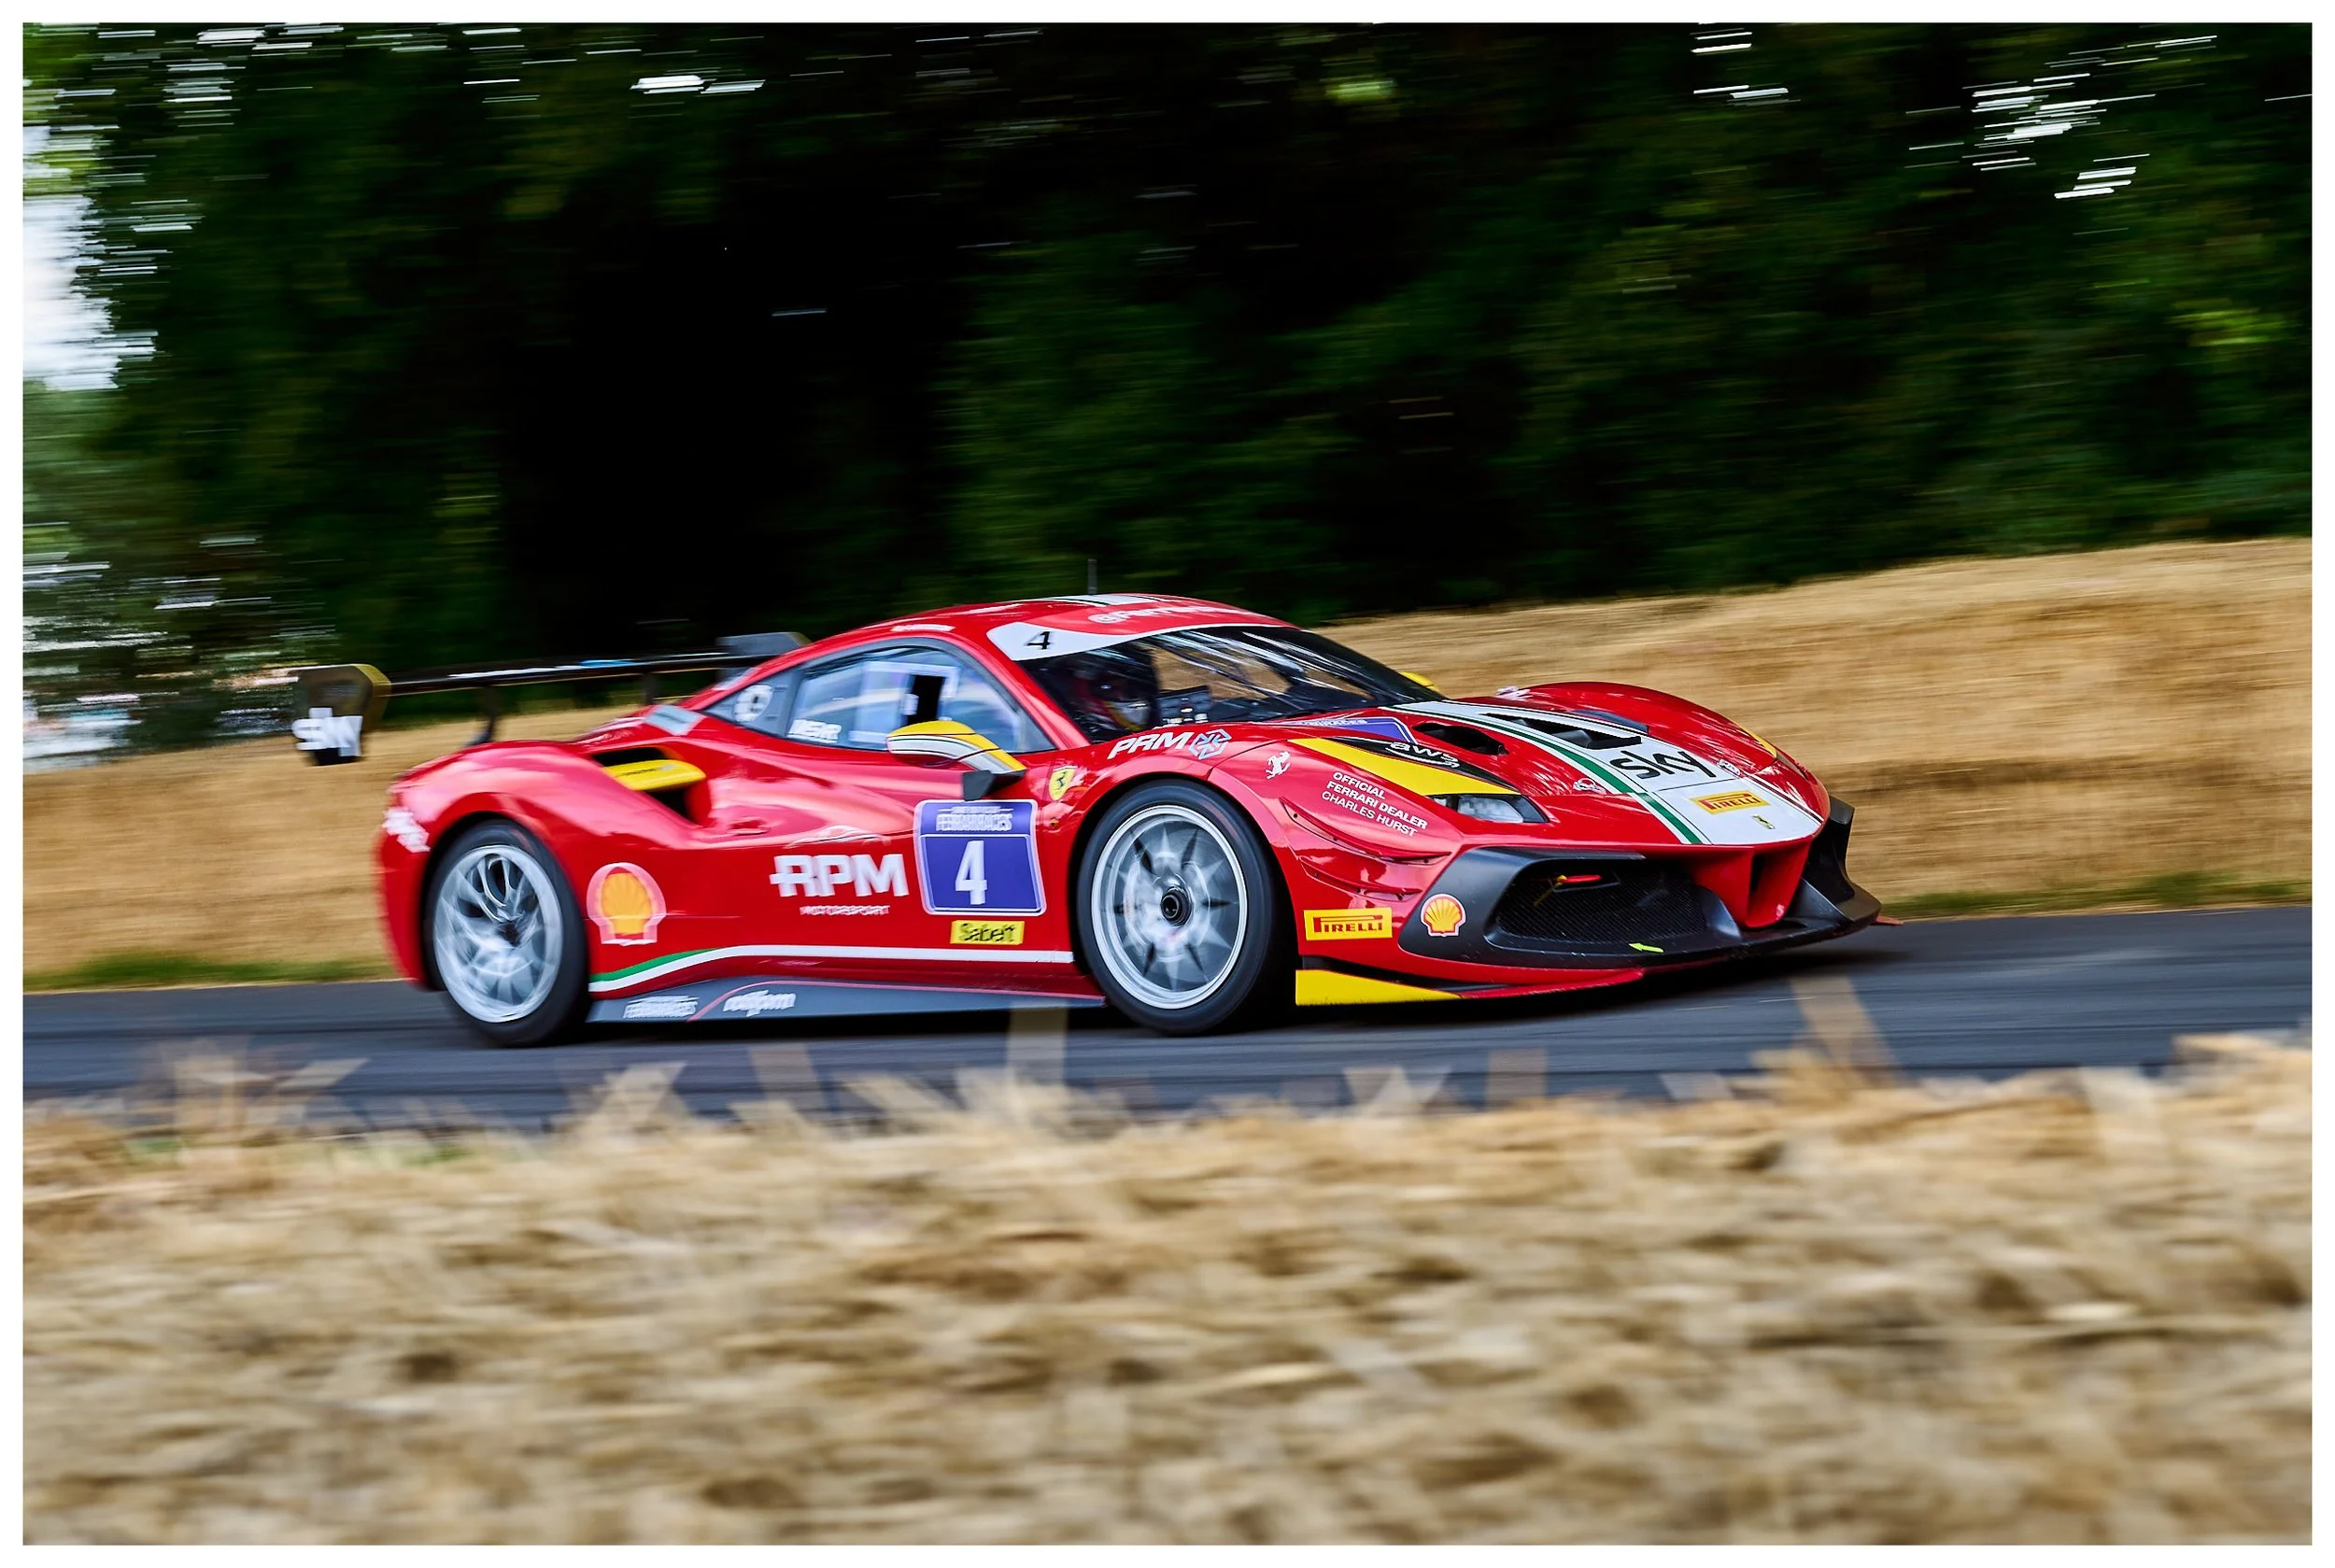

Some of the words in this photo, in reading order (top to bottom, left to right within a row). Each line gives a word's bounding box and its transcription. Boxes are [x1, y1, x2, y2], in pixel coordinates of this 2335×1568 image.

[1025, 631, 1054, 650] 4
[1107, 731, 1196, 759] PRM
[1389, 742, 1459, 764] aws
[1609, 750, 1717, 779] sky
[1333, 771, 1385, 800] OFFICIAL
[1322, 790, 1376, 820] CHARLES
[1376, 814, 1418, 837] HURST
[1326, 781, 1377, 808] FERRARI
[1380, 803, 1428, 830] DEALER
[1698, 793, 1762, 810] PIRELLI
[769, 854, 910, 897] RPM
[955, 840, 988, 905] 4
[1313, 915, 1383, 933] PIRELLI
